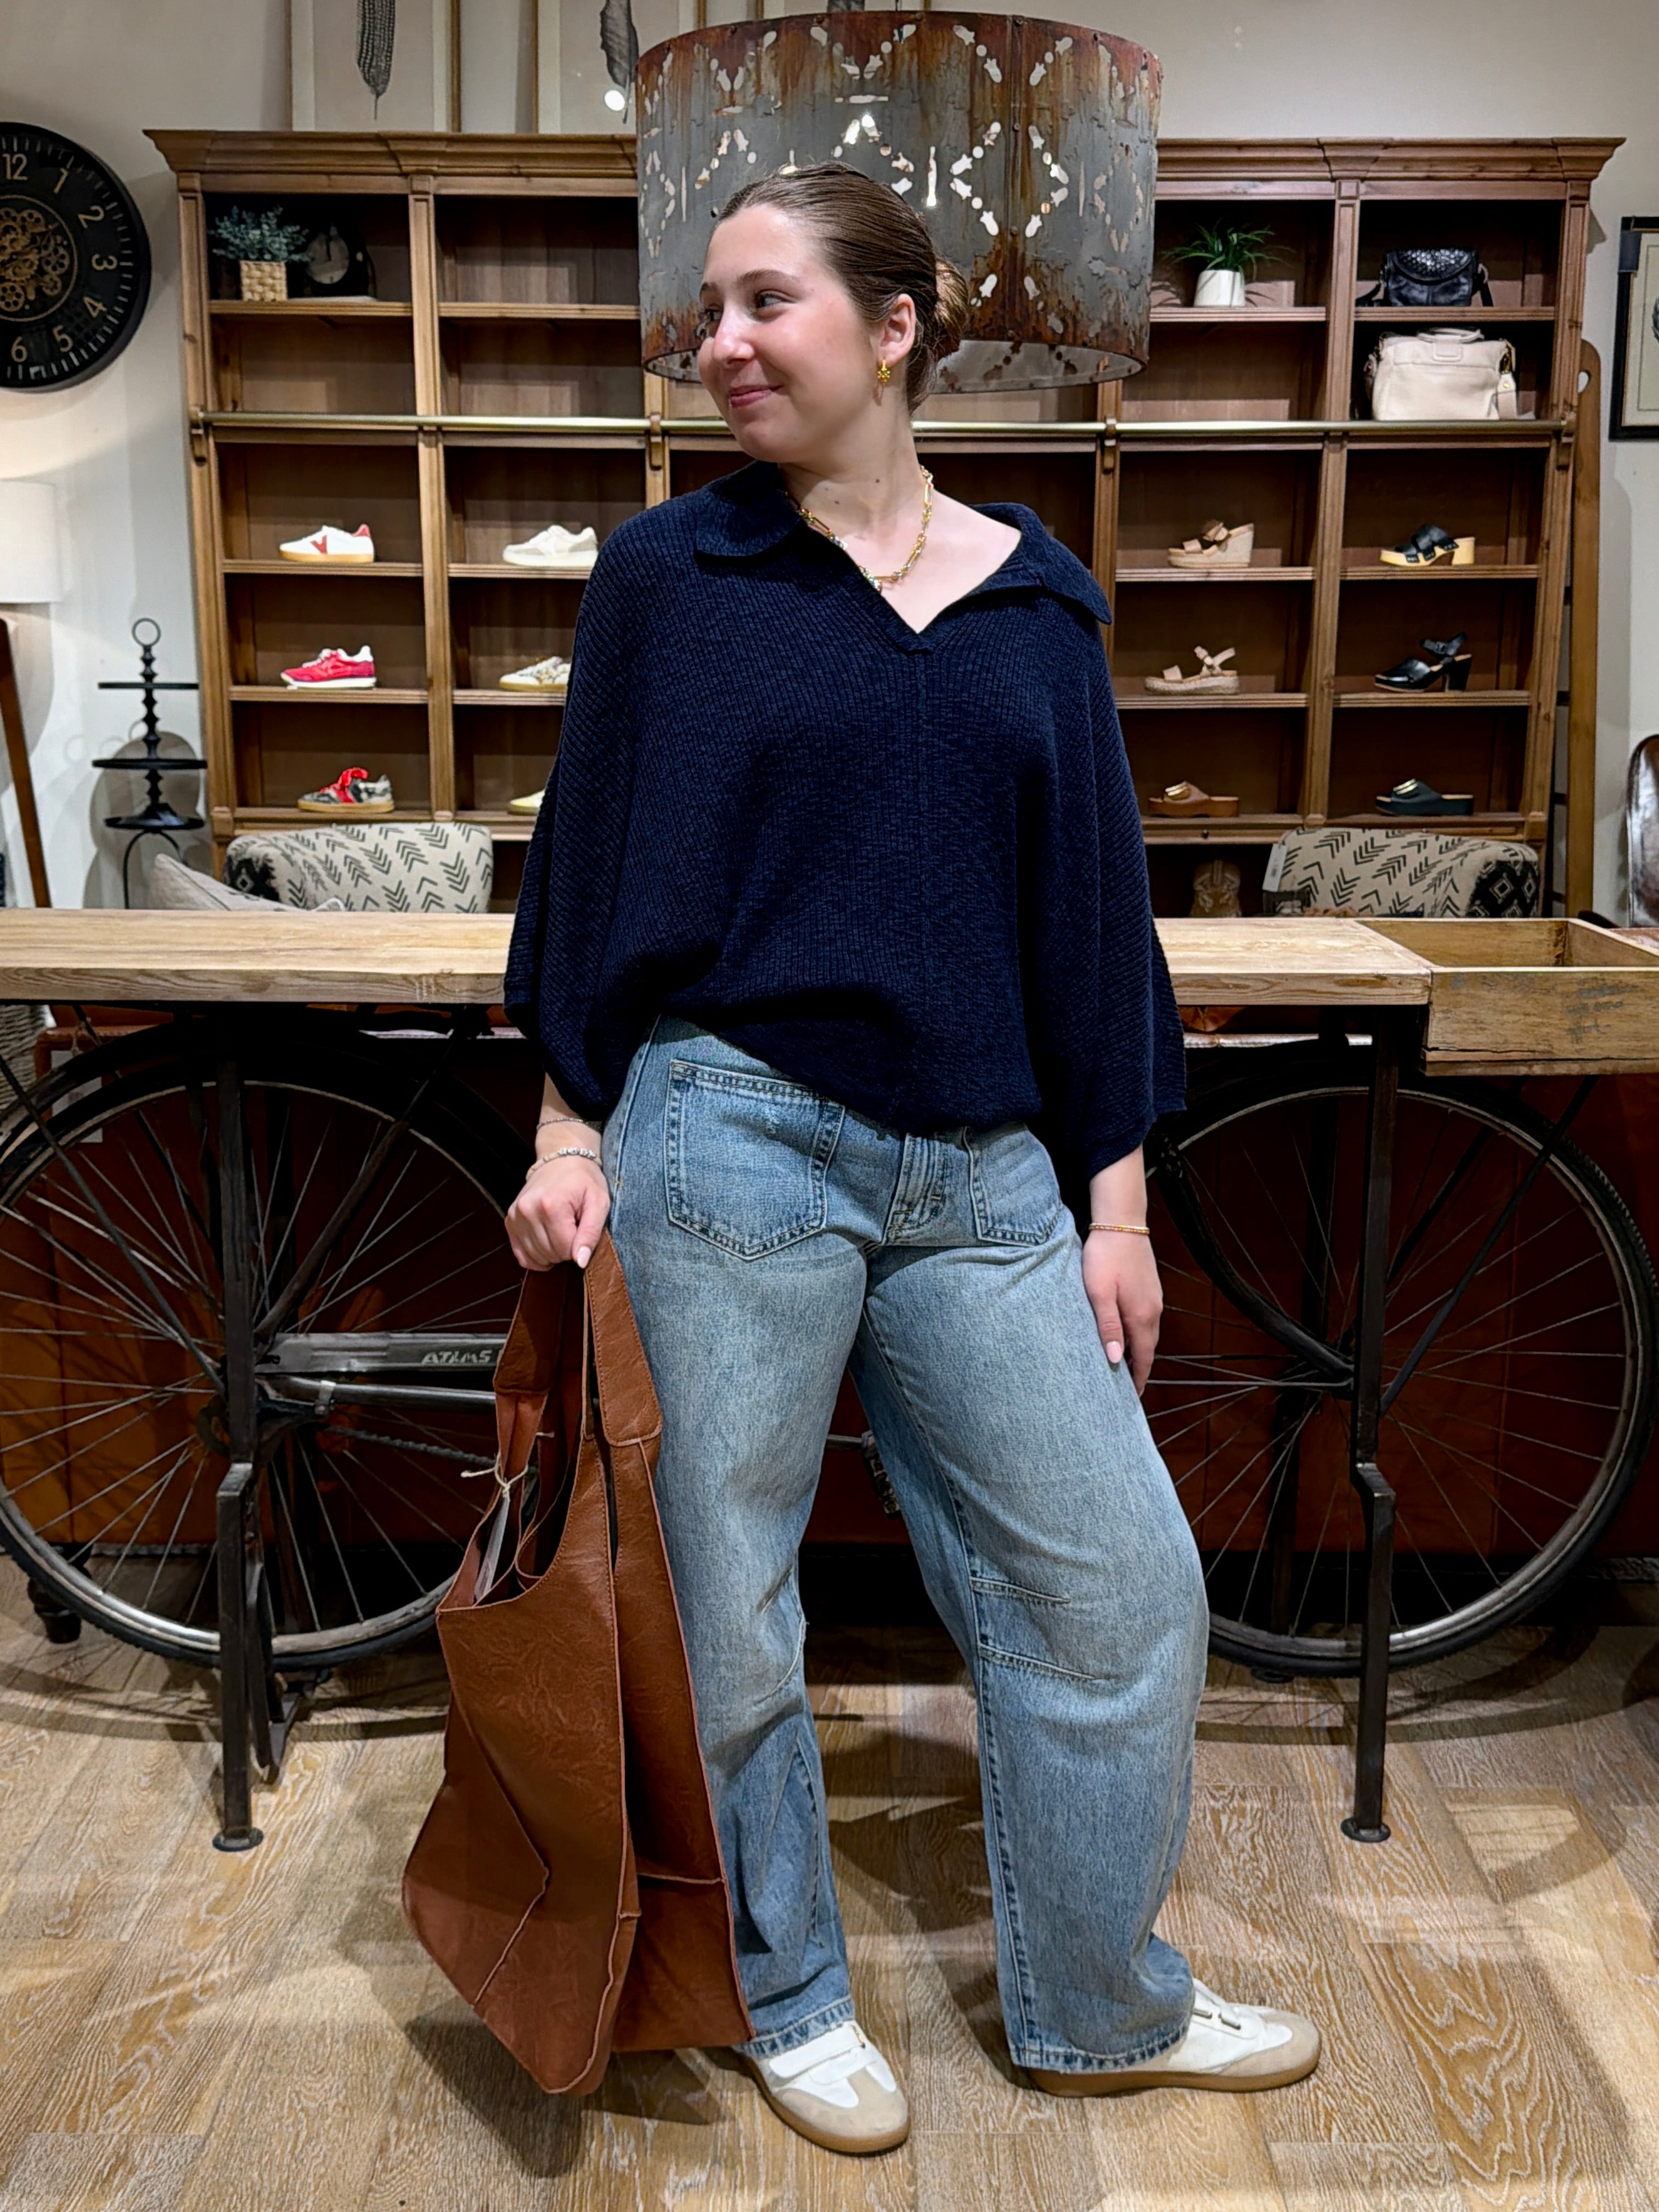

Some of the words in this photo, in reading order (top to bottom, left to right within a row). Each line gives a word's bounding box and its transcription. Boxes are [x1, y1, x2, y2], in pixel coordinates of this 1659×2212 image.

[2, 153, 27, 180] 12
[54, 168, 69, 193] 1
[78, 205, 104, 228] 2
[92, 253, 117, 270] 3
[83, 296, 107, 317] 4
[11, 336, 27, 362] 6
[53, 325, 73, 352] 5
